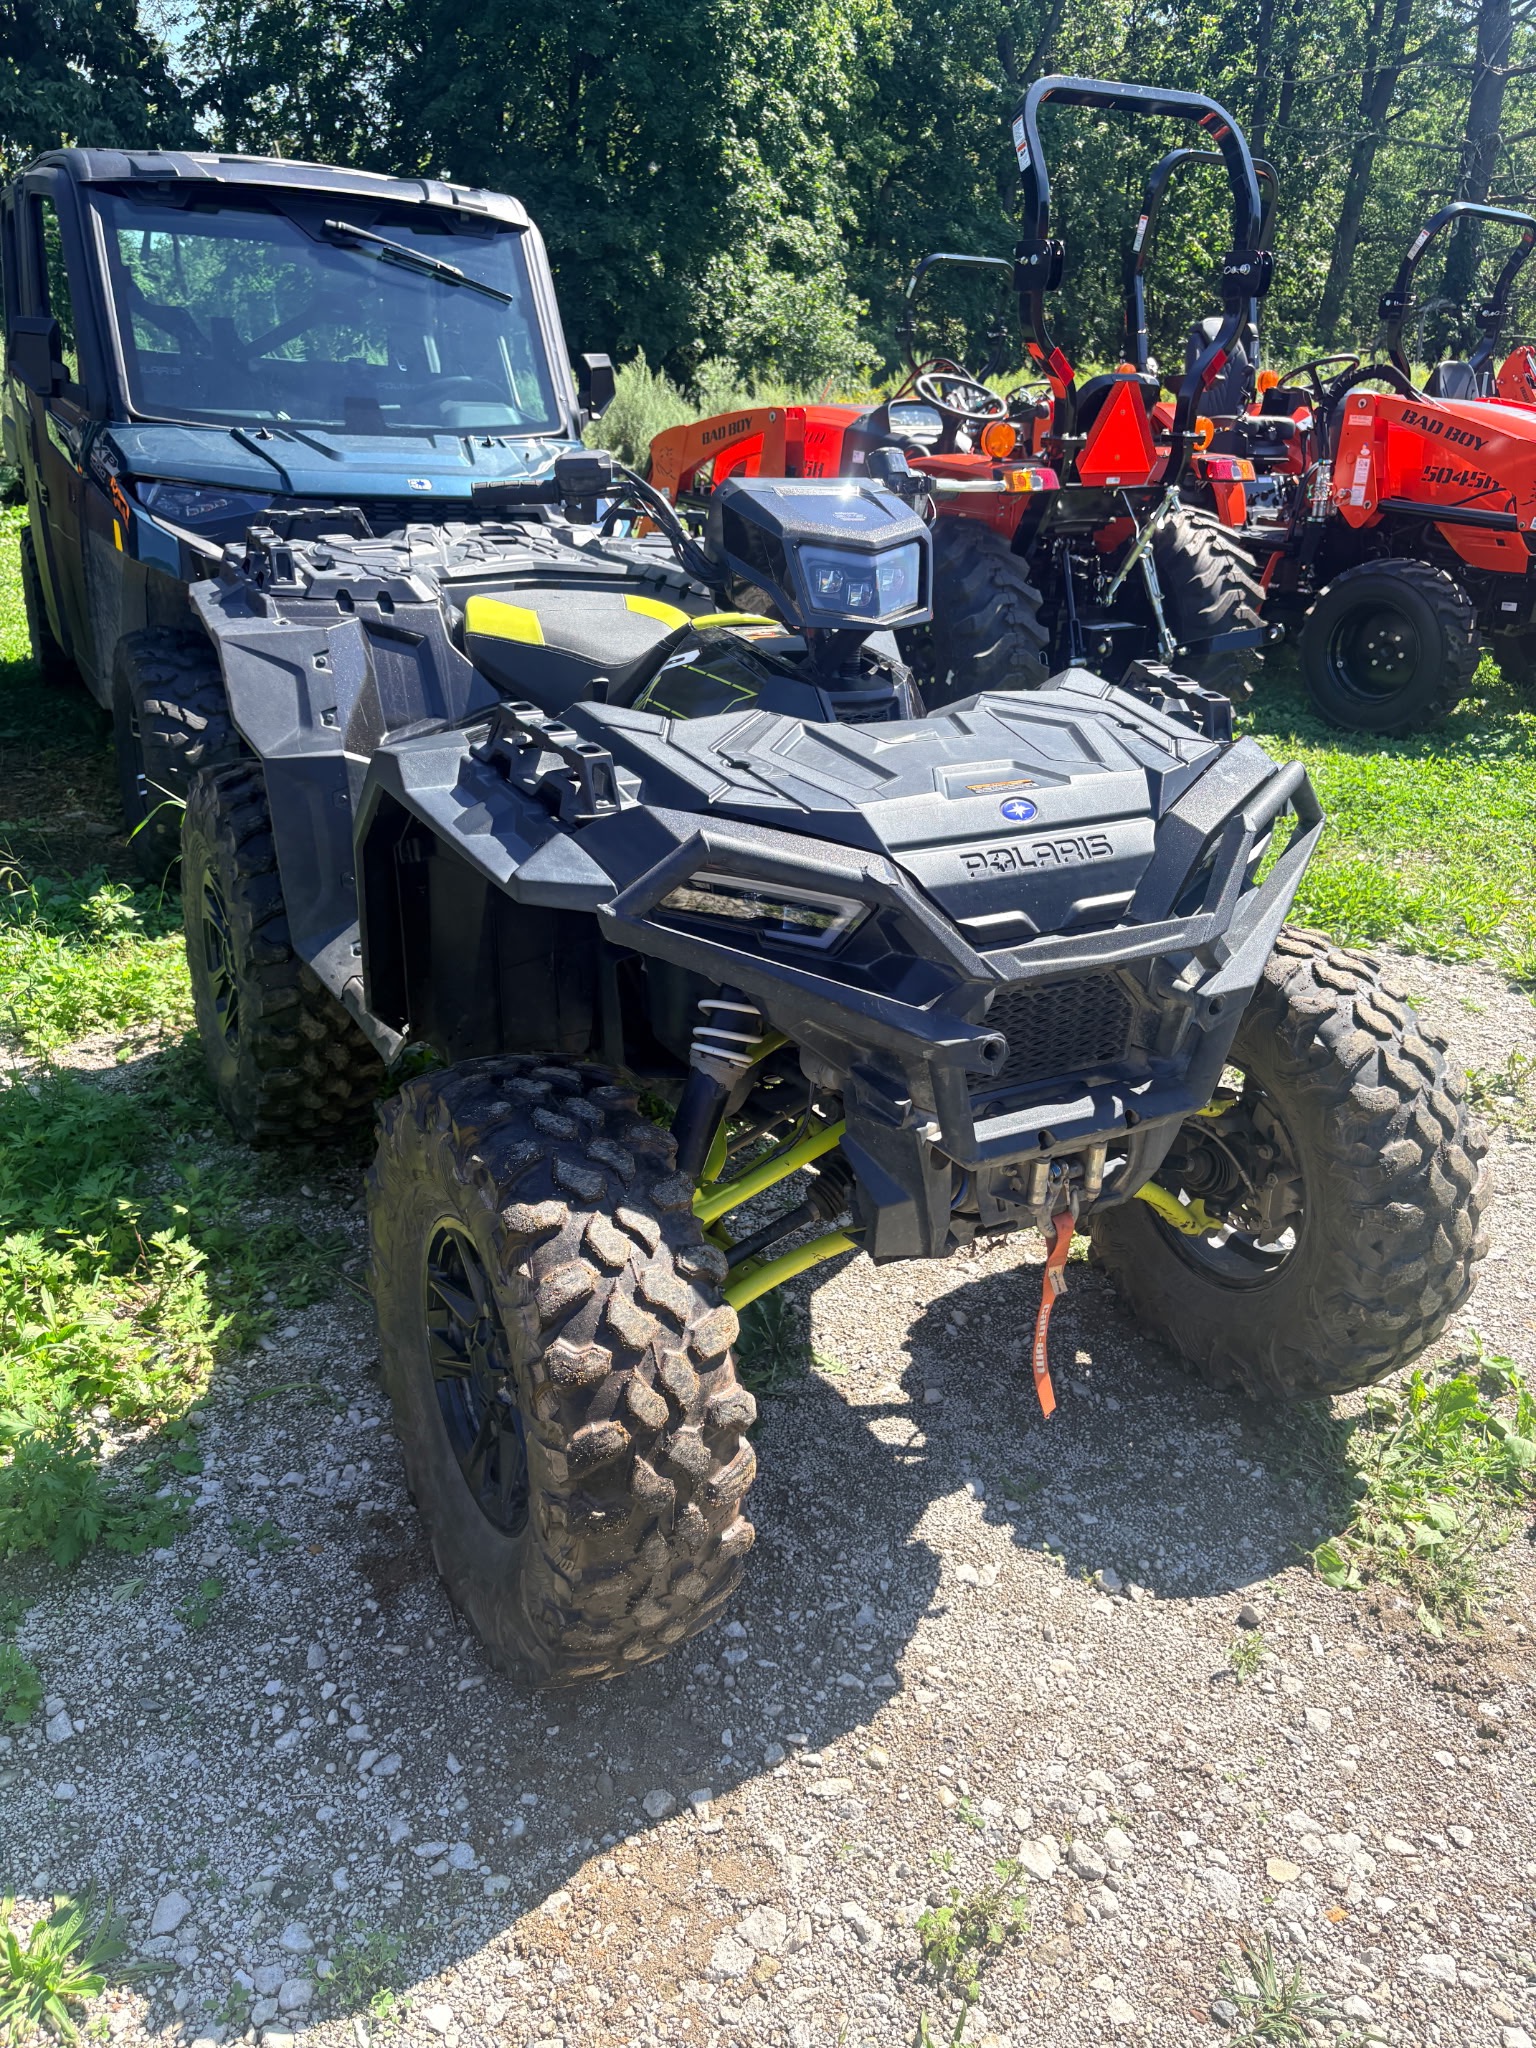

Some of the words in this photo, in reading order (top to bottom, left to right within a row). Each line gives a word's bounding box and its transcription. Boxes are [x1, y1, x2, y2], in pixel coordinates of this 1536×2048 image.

[702, 427, 726, 445] BAD
[728, 417, 753, 437] BOY
[1401, 409, 1444, 435] BAD
[1444, 426, 1489, 451] BOY
[93, 439, 118, 468] XP
[959, 834, 1114, 878] POLARIS
[1035, 1303, 1051, 1374] can-am
